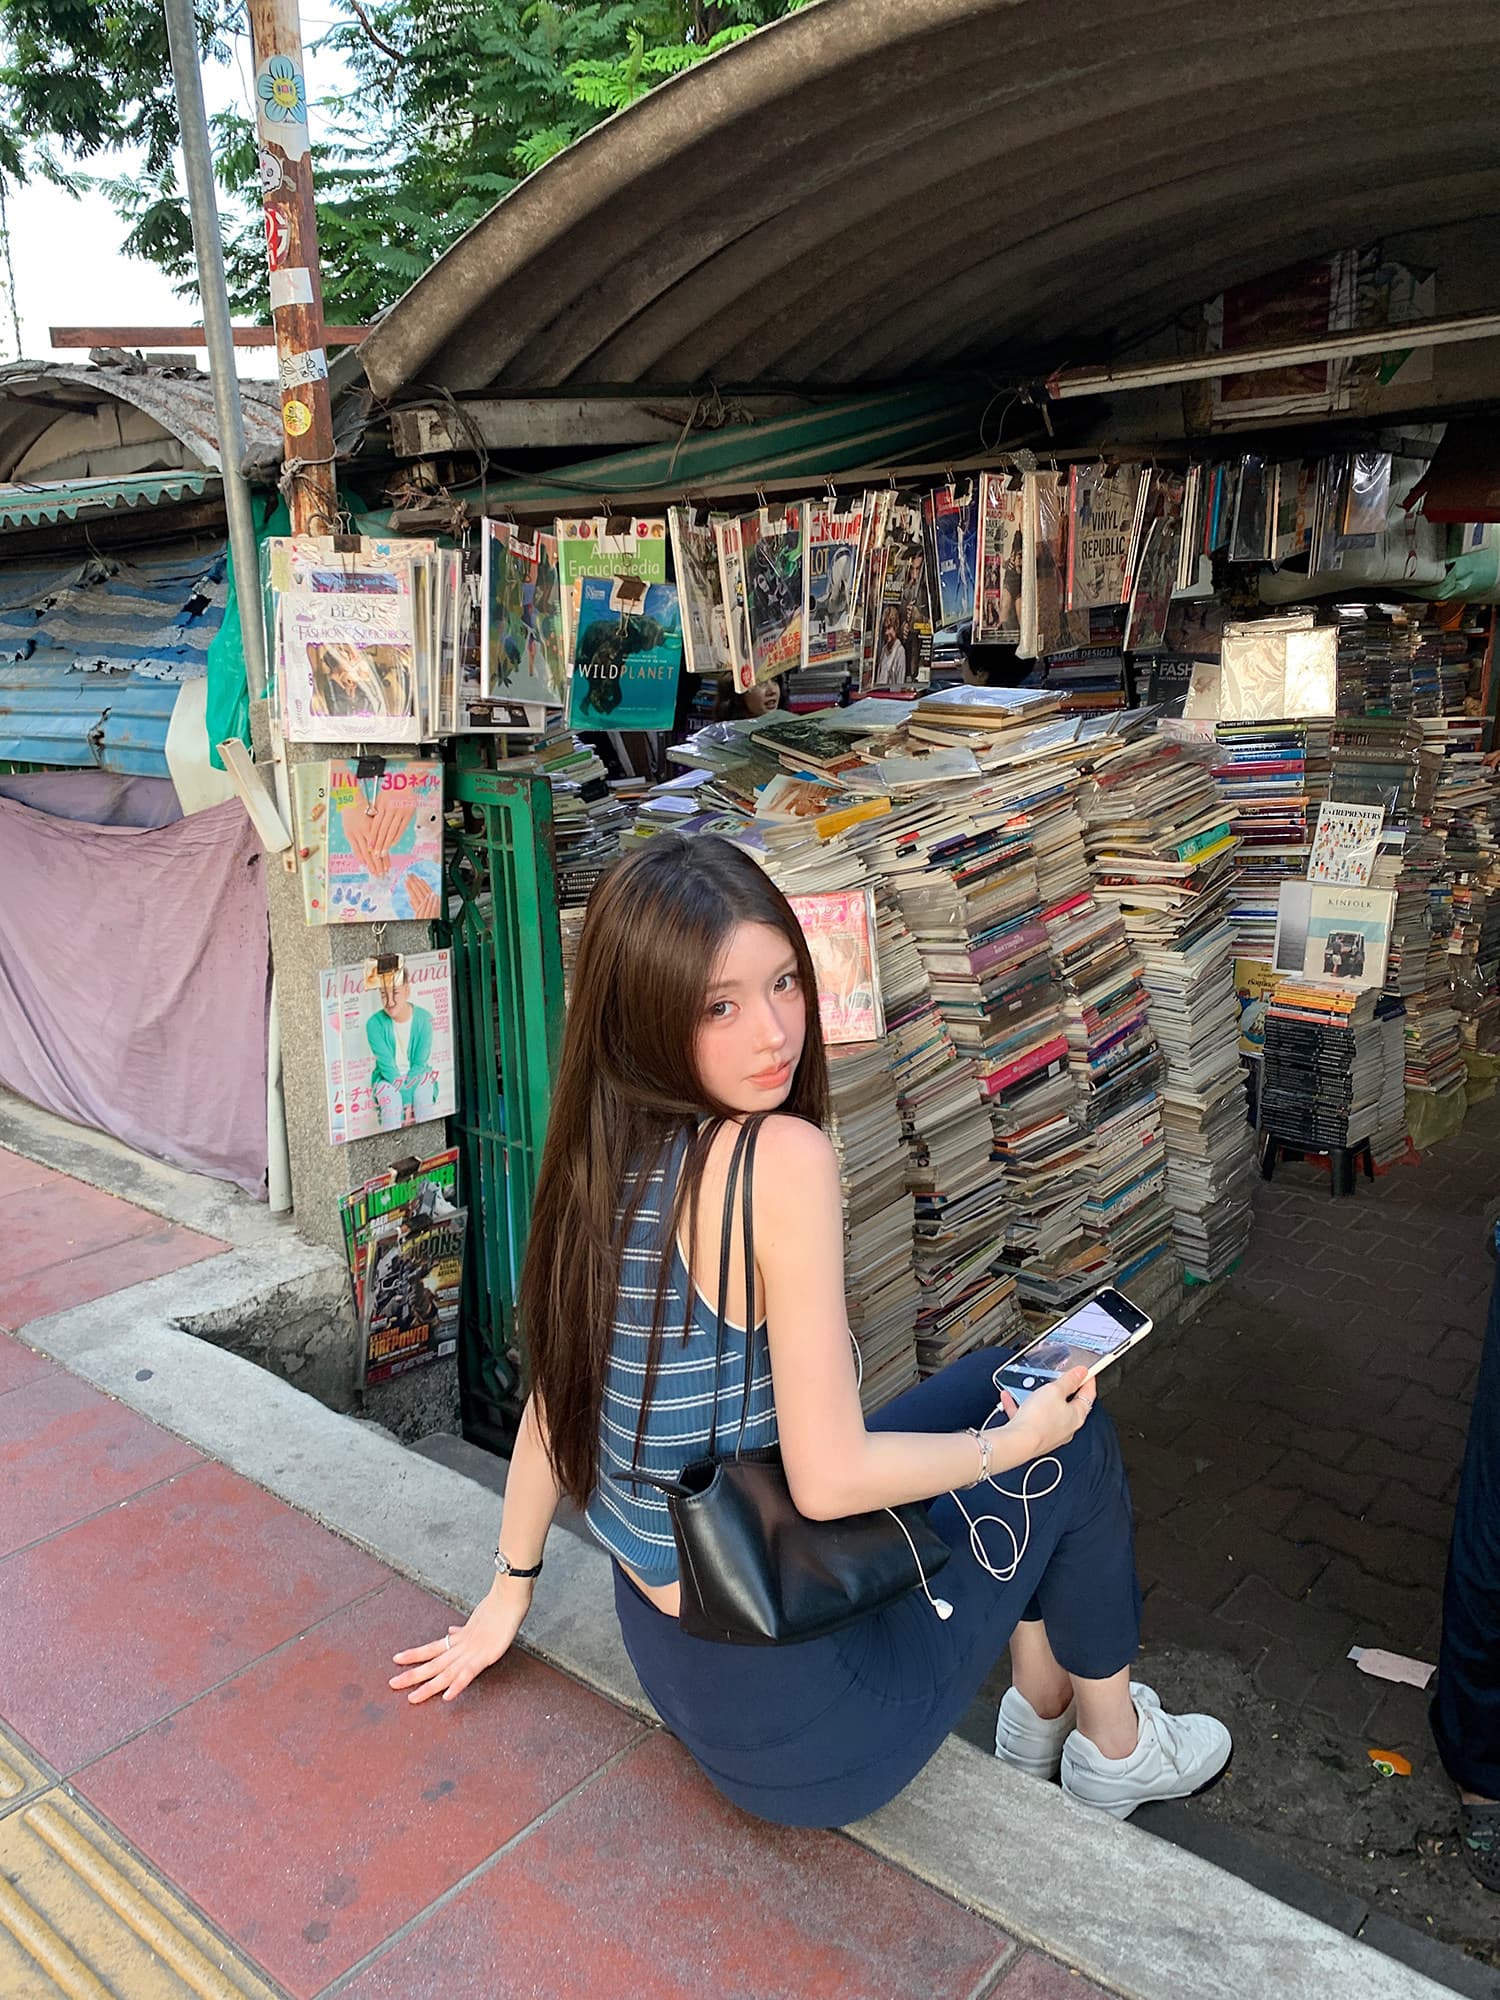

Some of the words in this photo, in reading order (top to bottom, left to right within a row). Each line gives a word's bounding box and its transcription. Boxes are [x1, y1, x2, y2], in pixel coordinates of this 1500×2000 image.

[1092, 510, 1118, 531] VINYL
[1082, 536, 1126, 560] REPUBLIC
[1081, 647, 1114, 658] DESIGN
[1328, 898, 1373, 909] KINFOLK
[369, 1324, 430, 1360] FIREPOWER
